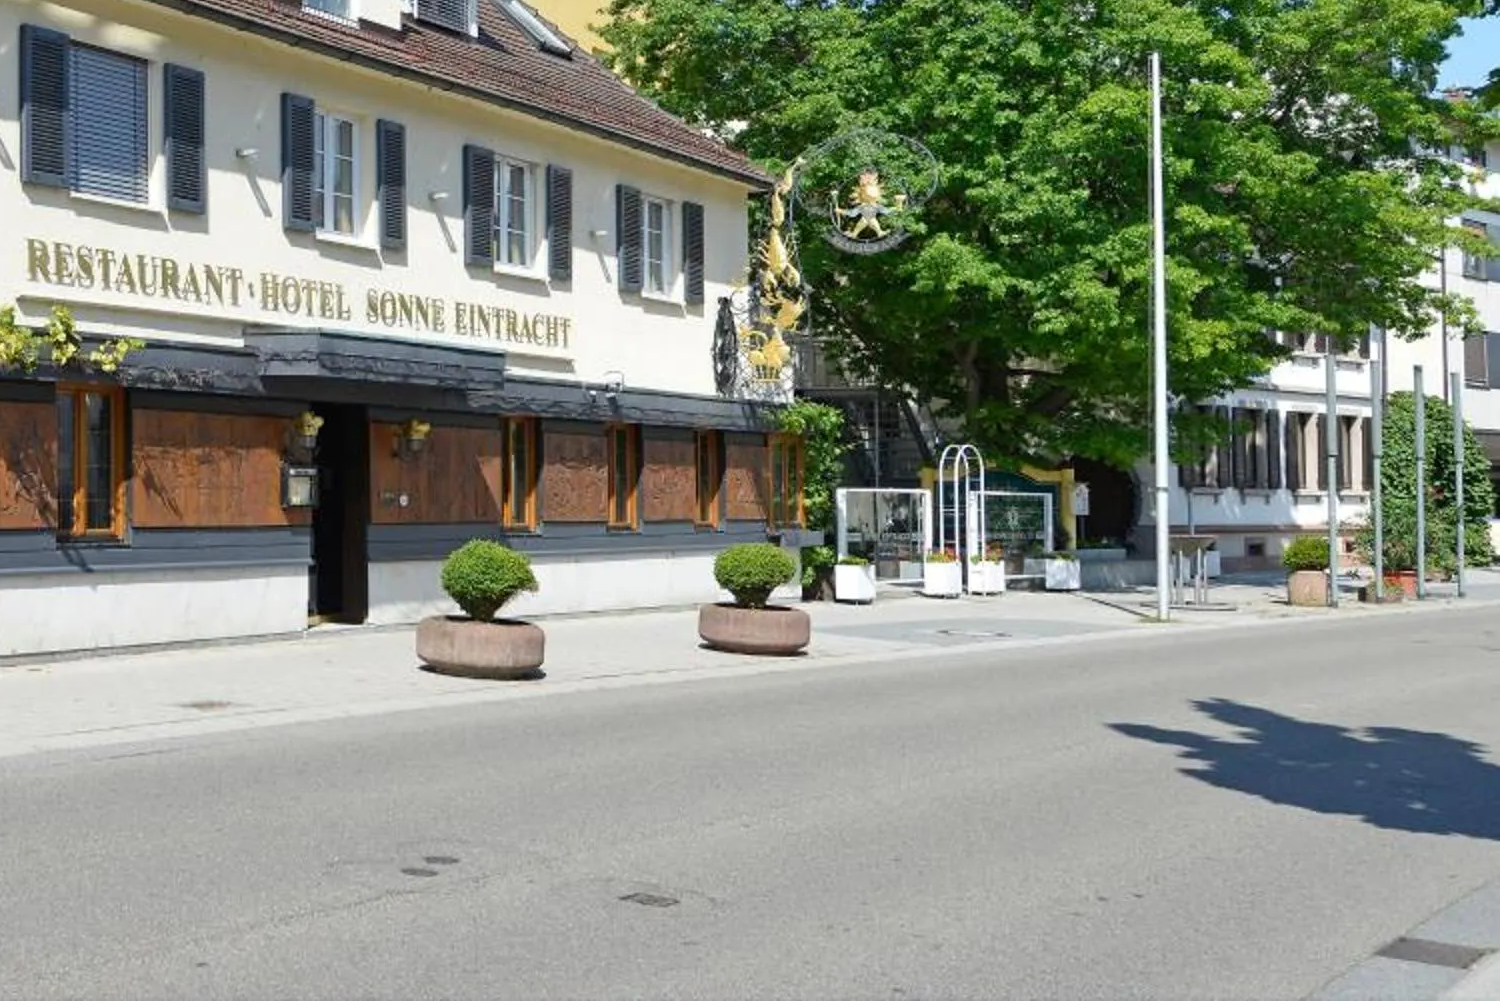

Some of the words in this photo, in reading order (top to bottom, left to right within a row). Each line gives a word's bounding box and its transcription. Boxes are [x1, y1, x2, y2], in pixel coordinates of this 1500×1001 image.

[26, 238, 243, 307] RESTAURANT
[260, 272, 351, 322] HOTEL
[366, 288, 445, 334] SONNE
[454, 301, 573, 350] EINTRACHT
